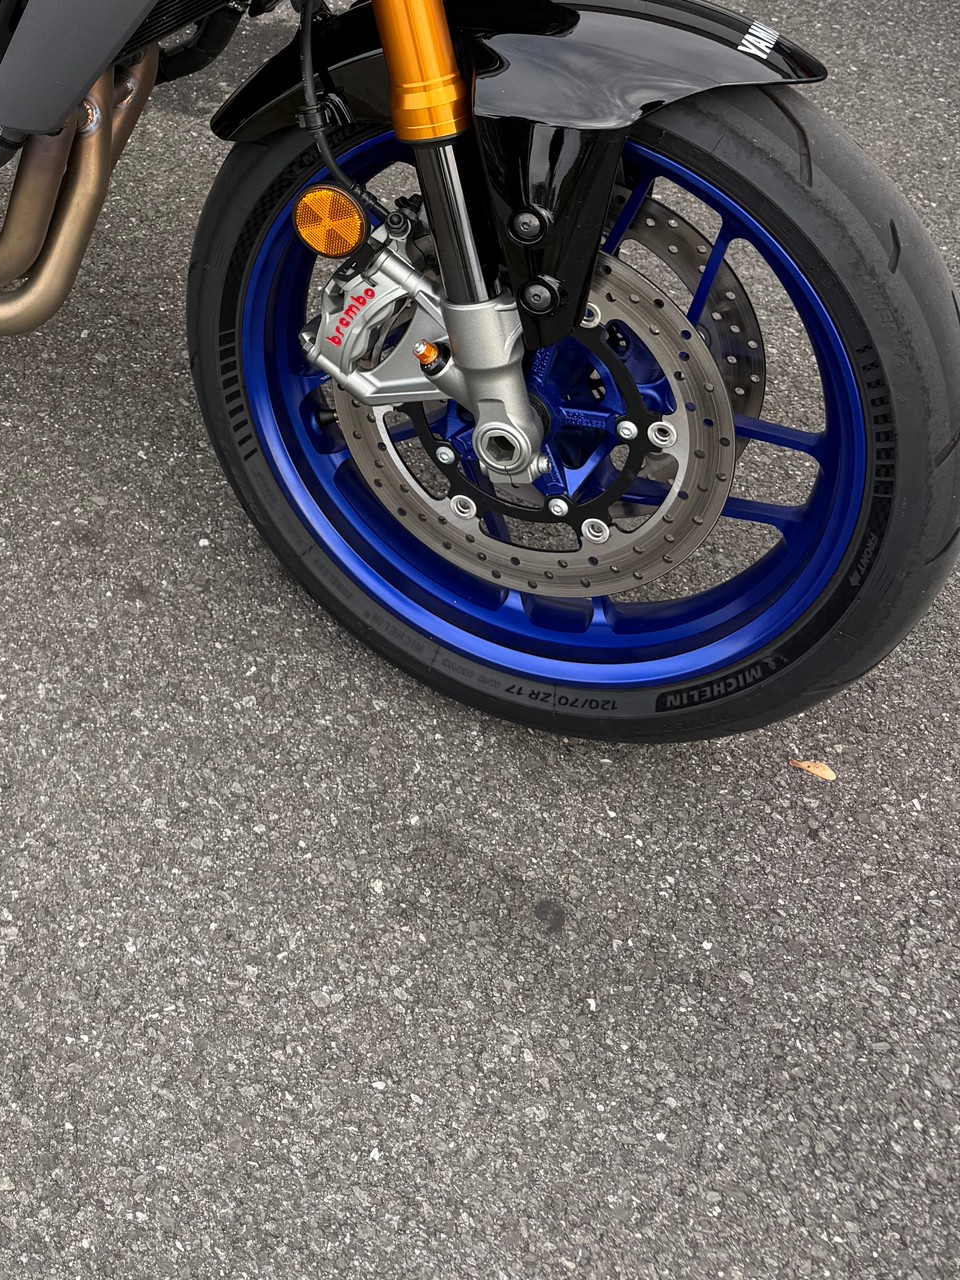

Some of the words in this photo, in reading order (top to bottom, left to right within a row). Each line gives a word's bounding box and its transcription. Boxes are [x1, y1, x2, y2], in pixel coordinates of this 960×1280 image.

[326, 287, 376, 348] brembo
[852, 531, 879, 578] FRONT
[504, 684, 523, 697] 17
[528, 689, 552, 704] ZR
[666, 665, 762, 708] MICHELIN
[558, 695, 619, 711] 120/70
